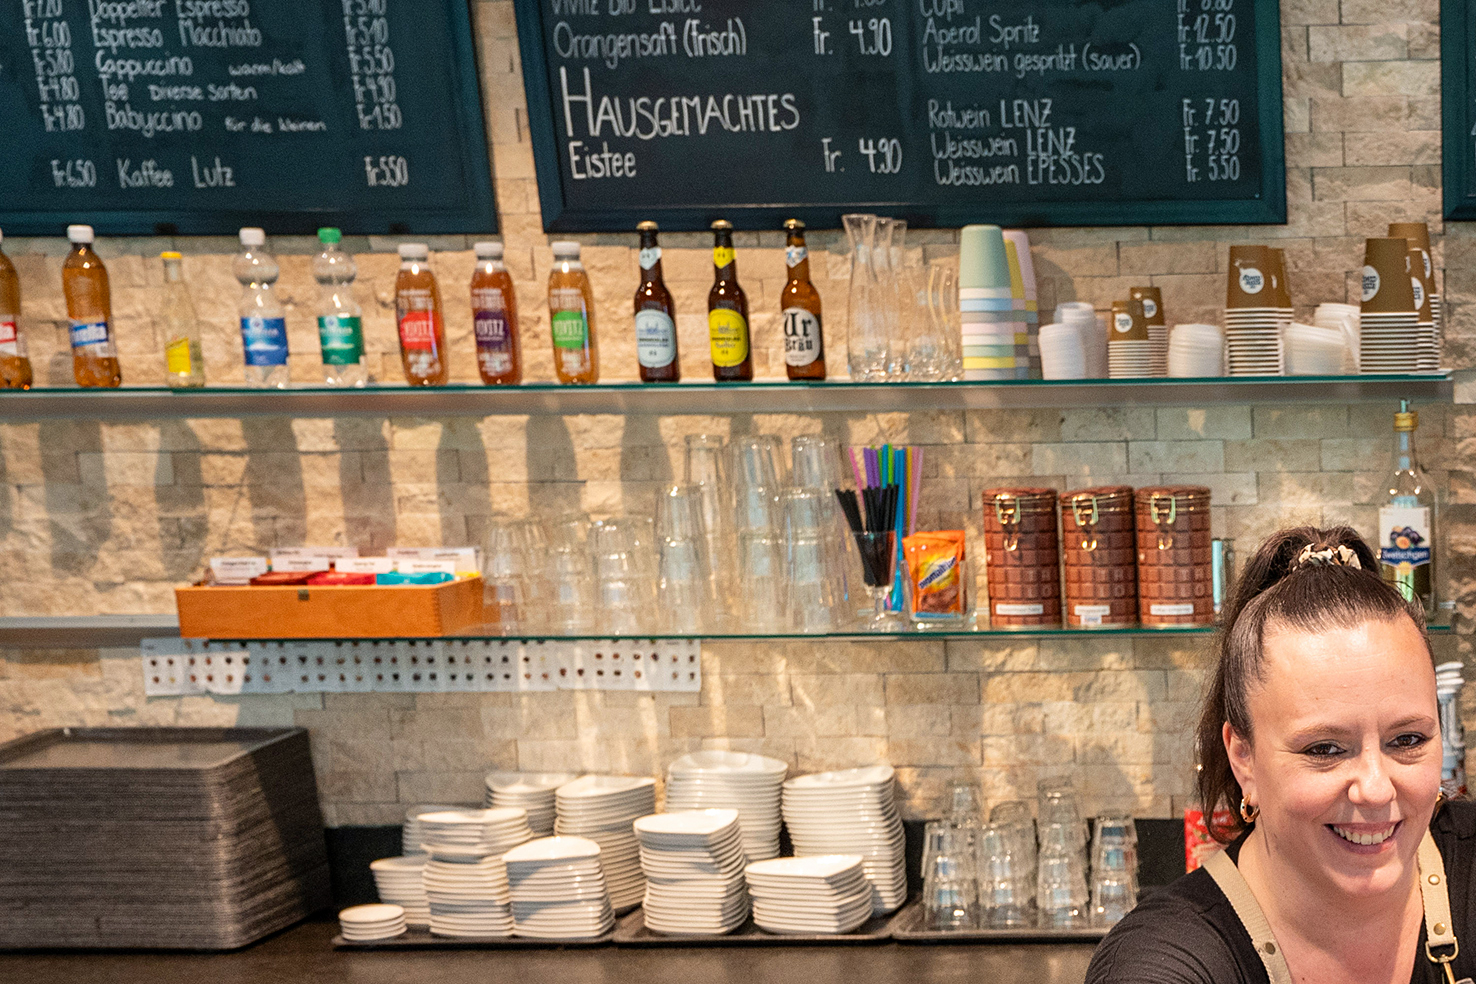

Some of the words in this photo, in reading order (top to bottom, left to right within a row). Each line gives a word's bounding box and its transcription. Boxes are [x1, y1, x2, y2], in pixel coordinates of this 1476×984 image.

[90, 18, 164, 54] Espresso
[812, 16, 834, 55] Fr.
[849, 17, 893, 56] 4.90
[989, 14, 1041, 51] Spritz
[95, 49, 194, 83] Cappuccino
[923, 45, 1009, 74] Weisswein
[104, 100, 203, 138] Babyccino
[559, 65, 801, 140] HAUSGEMACHTES
[928, 99, 991, 129] Rotwein
[1000, 98, 1053, 128] LENZ
[1183, 98, 1198, 126] Fr.
[1205, 98, 1240, 126] 7.50
[821, 137, 847, 173] Fr.
[858, 137, 903, 174] 4.90
[931, 132, 1018, 160] Weisswein
[1025, 127, 1077, 157] LENZ
[1206, 127, 1241, 155] 7.50
[116, 157, 175, 189] Kaffee
[191, 154, 237, 188] Lutz
[568, 141, 637, 180] Eistee
[933, 158, 1021, 186] Weisswein
[1026, 153, 1106, 185] EPESSES
[784, 313, 812, 338] Ur
